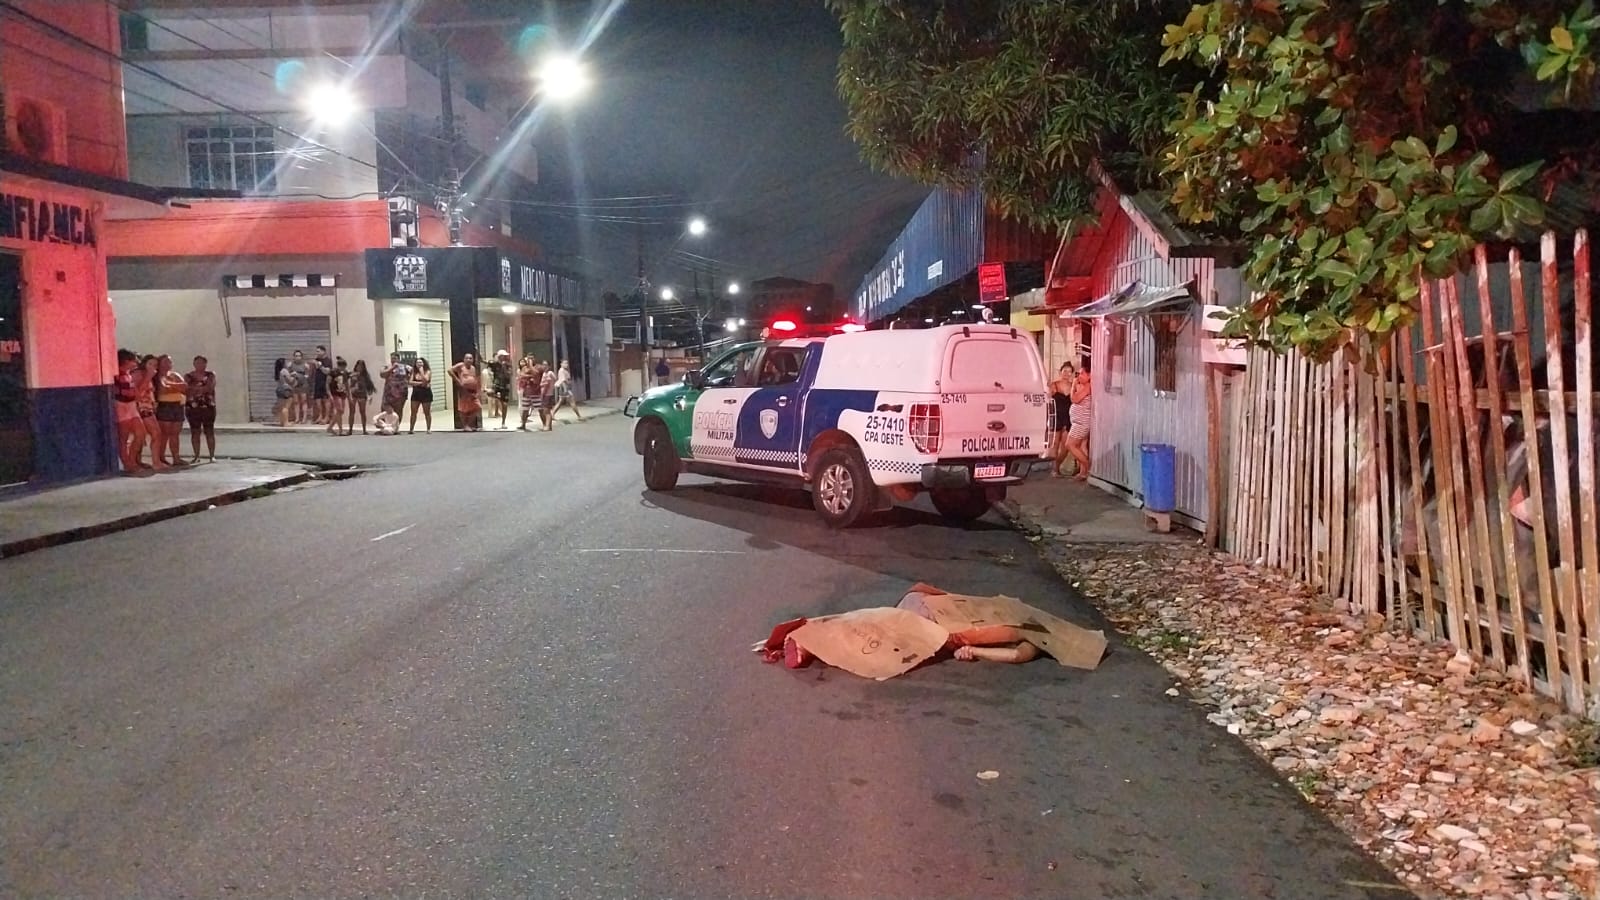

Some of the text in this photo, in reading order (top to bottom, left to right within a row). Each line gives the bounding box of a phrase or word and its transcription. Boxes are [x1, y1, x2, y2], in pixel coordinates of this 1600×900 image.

[941, 393, 967, 404] 25-7410
[1032, 393, 1045, 403] OESTE
[866, 415, 905, 432] 25-7410
[707, 430, 735, 441] MILITAR
[864, 430, 904, 446] CPA OESTE
[962, 434, 1031, 453] POLÍCIA MILITAR
